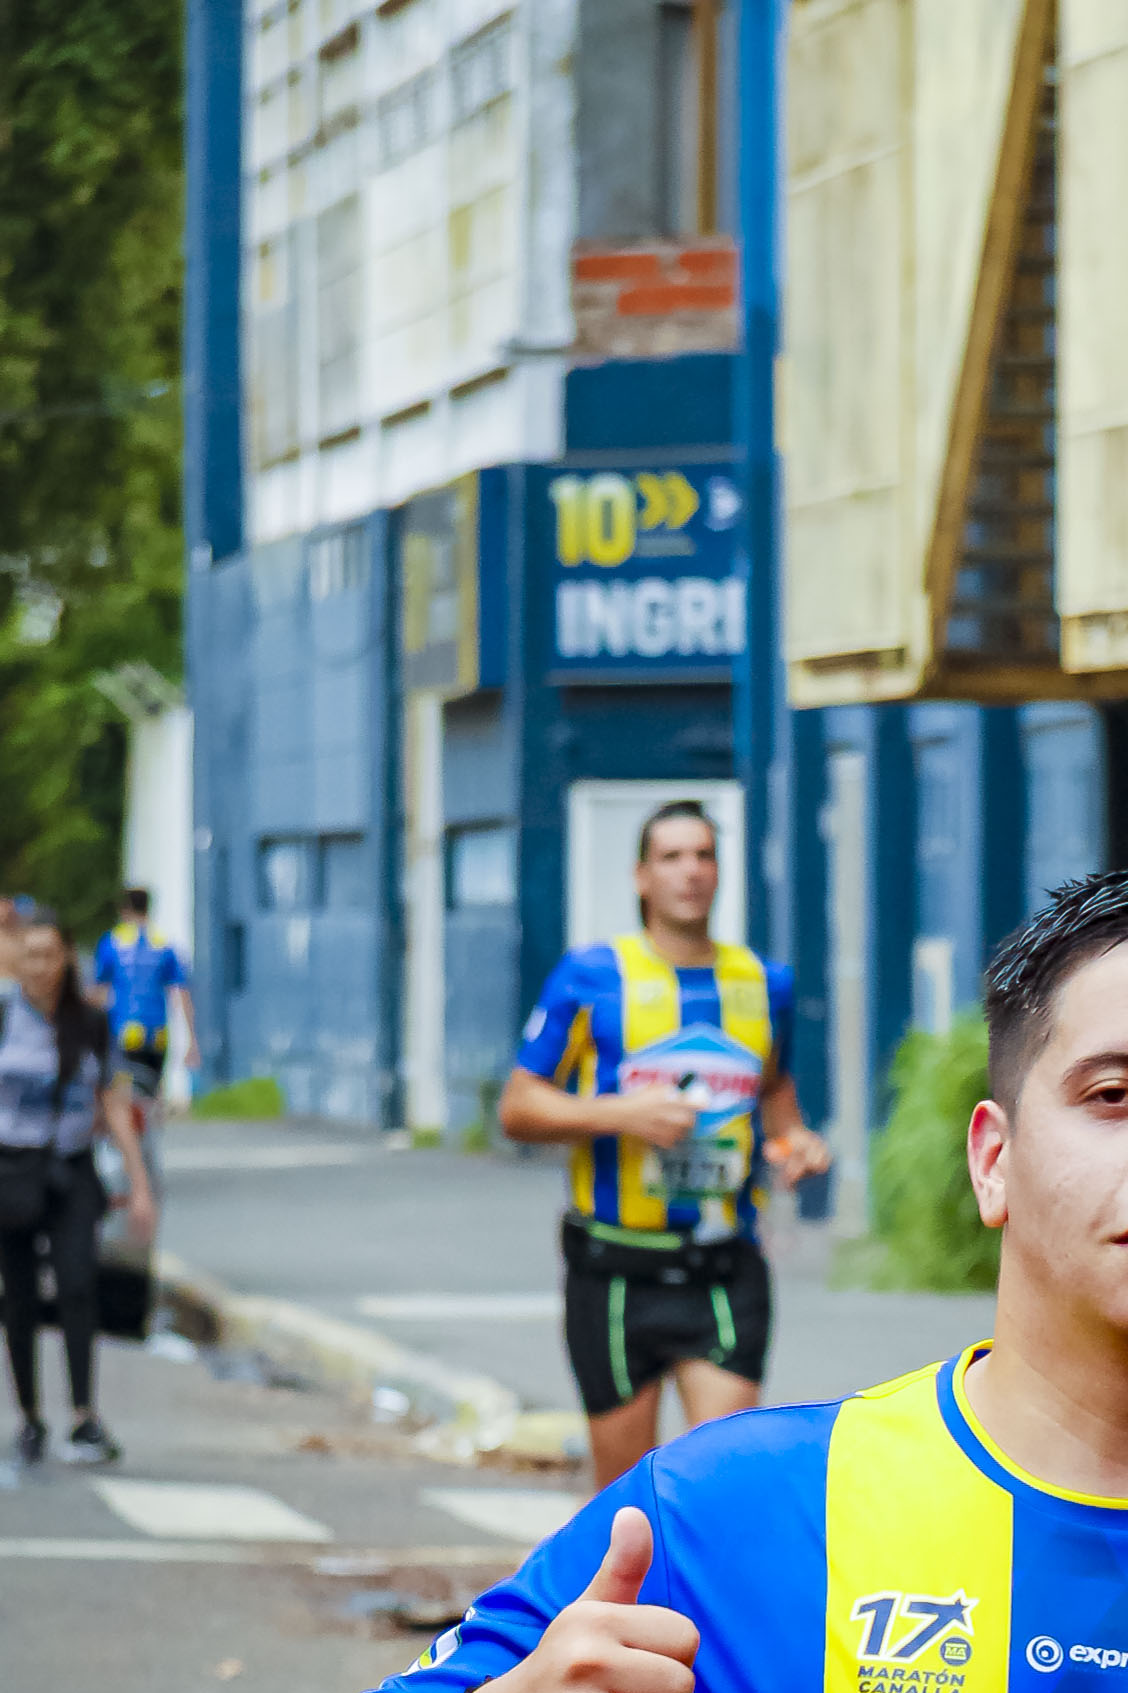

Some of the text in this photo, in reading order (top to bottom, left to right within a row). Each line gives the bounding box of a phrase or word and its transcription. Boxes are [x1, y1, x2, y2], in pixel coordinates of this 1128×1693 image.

[550, 473, 636, 567] 10
[853, 1592, 972, 1661] 17
[857, 1665, 967, 1687] MARATÓN
